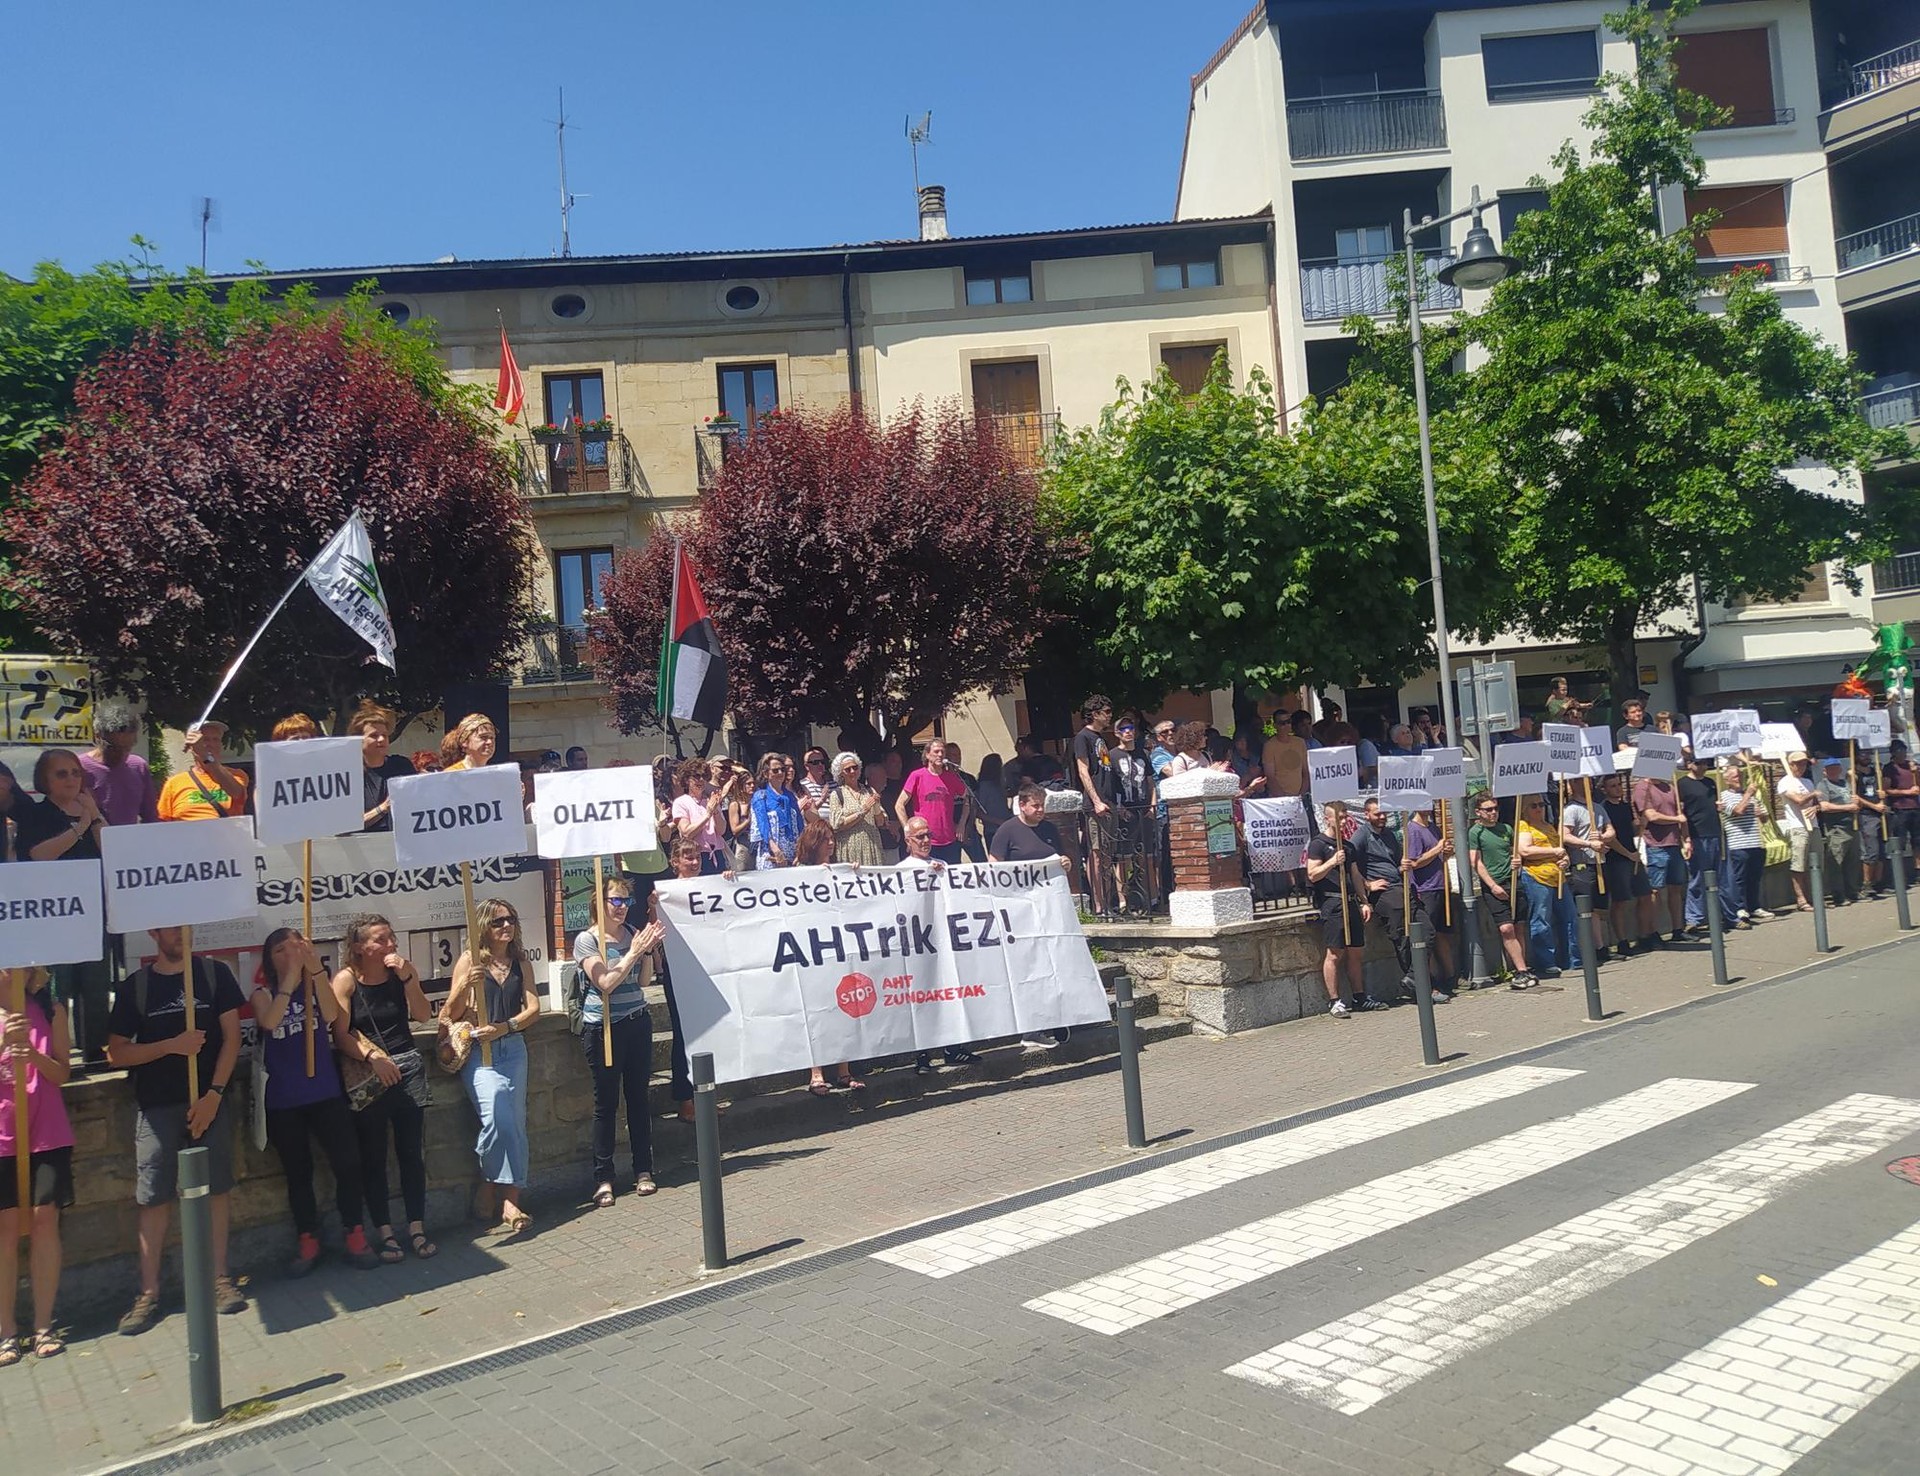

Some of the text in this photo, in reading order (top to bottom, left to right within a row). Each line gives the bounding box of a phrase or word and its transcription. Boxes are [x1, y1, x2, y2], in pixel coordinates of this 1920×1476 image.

[18, 724, 89, 740] AHTrik EZ!
[1700, 722, 1730, 733] UHARTE
[1550, 732, 1576, 744] ETXARRI
[1315, 763, 1353, 781] ALTSASU
[1499, 762, 1544, 777] BAKAIKU
[272, 771, 351, 808] ATAUN
[1384, 778, 1428, 791] URDIAIN
[411, 800, 503, 834] ZIORDI
[553, 799, 635, 825] OLAZTI
[1251, 819, 1295, 829] GEHIAGO,
[115, 858, 242, 890] IDIAZABAL
[688, 863, 1051, 916] Ez Gasteiztik! Ez Ezkiotik!
[772, 908, 1015, 973] AHTrik EZ!
[438, 939, 454, 968] 3
[882, 974, 914, 990] AHT
[840, 986, 874, 1005] STOP
[883, 984, 987, 1007] ZUNDAKETAK
